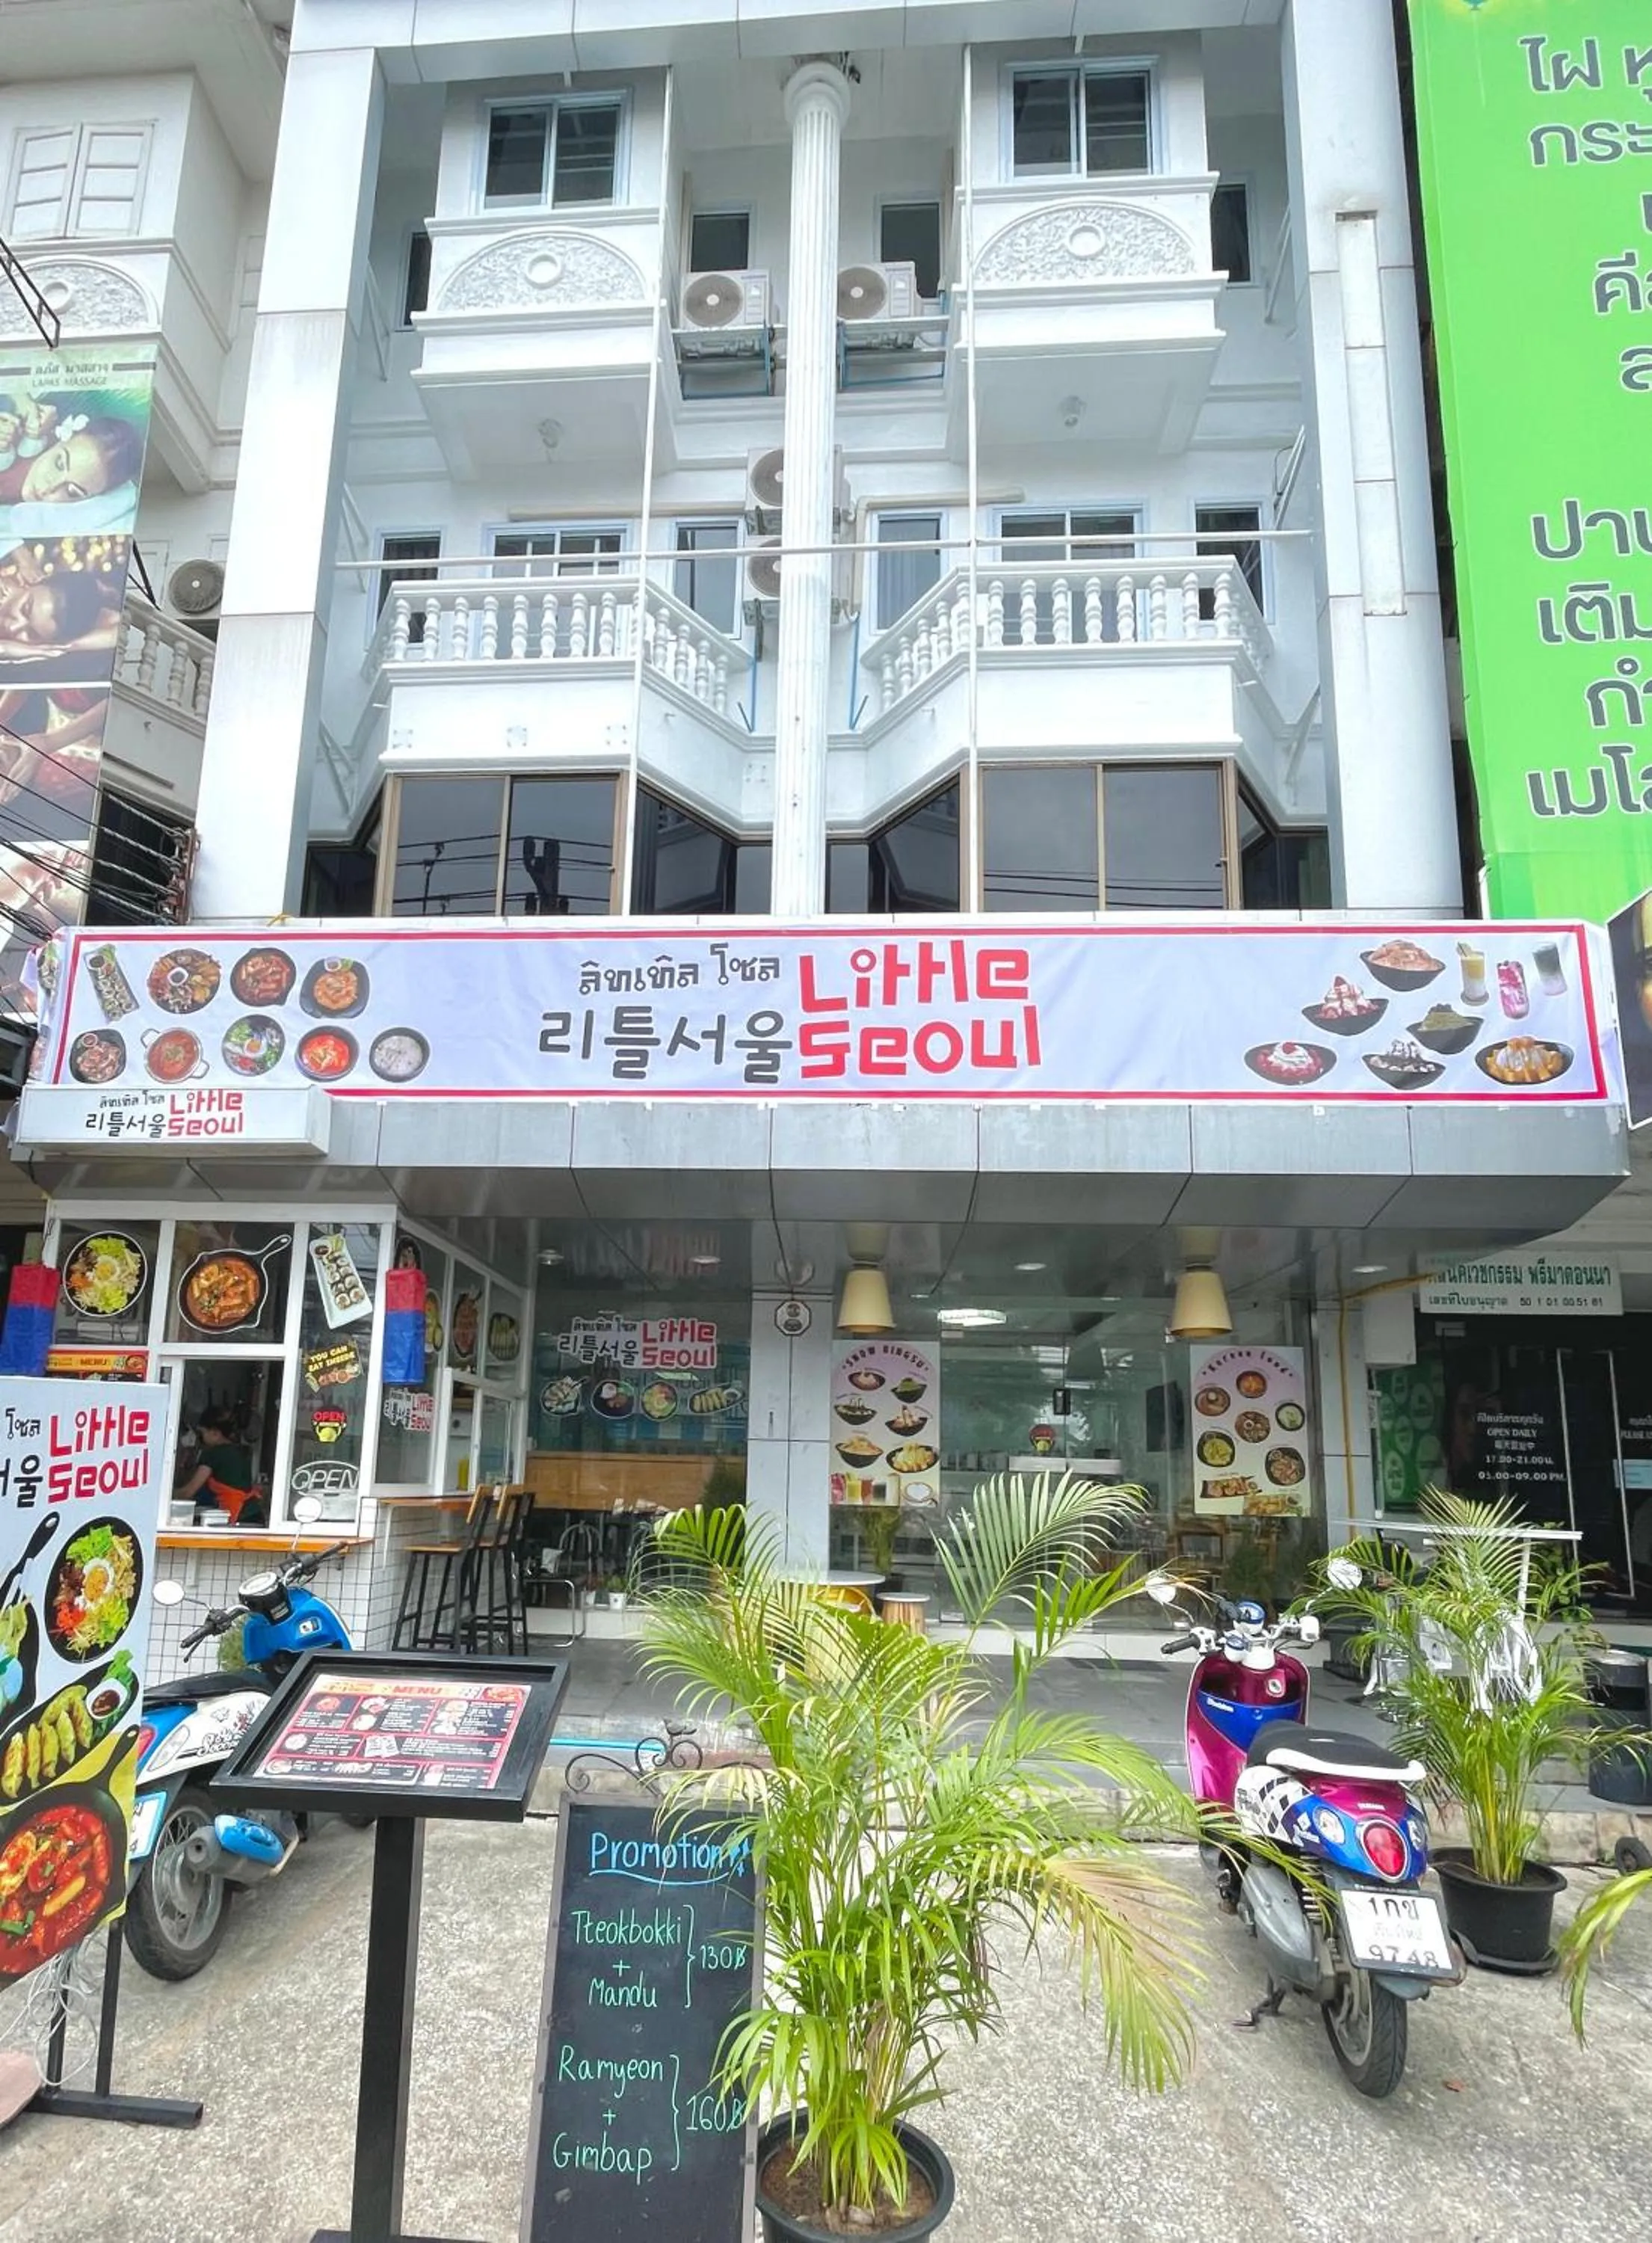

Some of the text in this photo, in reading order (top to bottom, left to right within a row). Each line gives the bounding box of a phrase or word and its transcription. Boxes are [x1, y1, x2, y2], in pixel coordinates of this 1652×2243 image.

[1520, 37, 1601, 91] ไฝ
[710, 943, 780, 985] โซล
[799, 940, 1029, 1012] Little
[539, 1005, 792, 1084] 리틀서울
[799, 1005, 1041, 1079] Seoul
[170, 1089, 243, 1115] Little
[86, 1112, 166, 1138] 리틀서울
[167, 1113, 243, 1136] Seoul
[642, 1320, 715, 1343] Little
[330, 1345, 348, 1356] CAN
[559, 1334, 639, 1366] 리틀서울
[642, 1346, 715, 1367] Seoul
[883, 1345, 926, 1368] BINGSU
[49, 1406, 150, 1457] Little
[313, 1410, 345, 1421] OPEN
[1487, 1428, 1538, 1438] OPEN DAILY
[48, 1449, 149, 1503] Seoul
[292, 1469, 360, 1490] OPEN
[392, 1685, 443, 1695] MENU
[591, 1832, 723, 1868] Promotion
[588, 1972, 657, 2009] Mandu
[558, 2045, 663, 2099] Ramyeon
[553, 2132, 653, 2185] Gimbap
